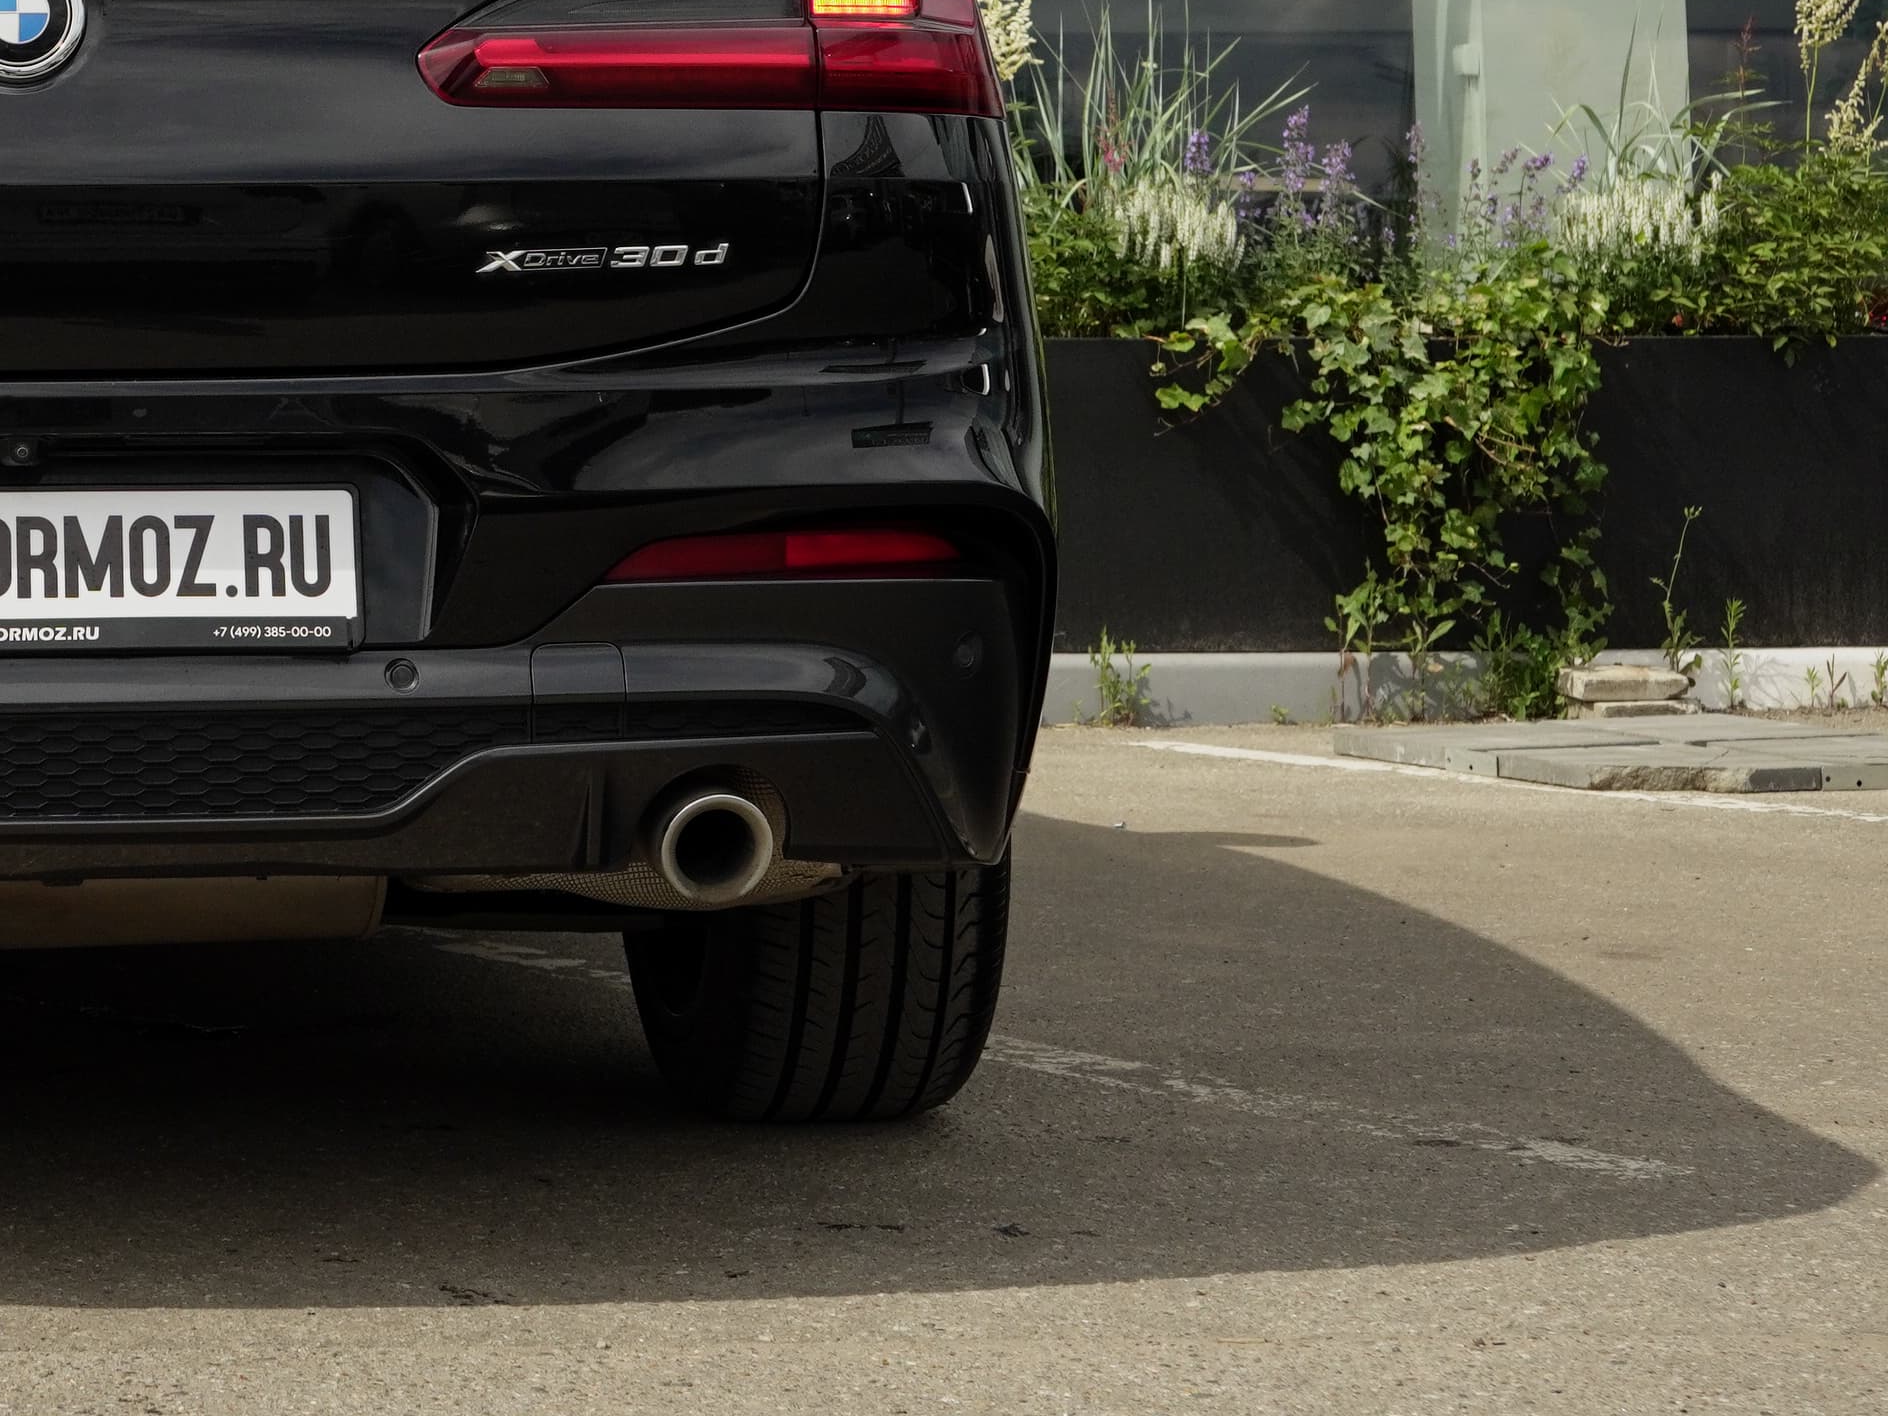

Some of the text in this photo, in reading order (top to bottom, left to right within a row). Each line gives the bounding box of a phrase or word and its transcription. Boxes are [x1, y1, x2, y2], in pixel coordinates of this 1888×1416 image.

[213, 625, 331, 639] +7 (499) 385-00-00
